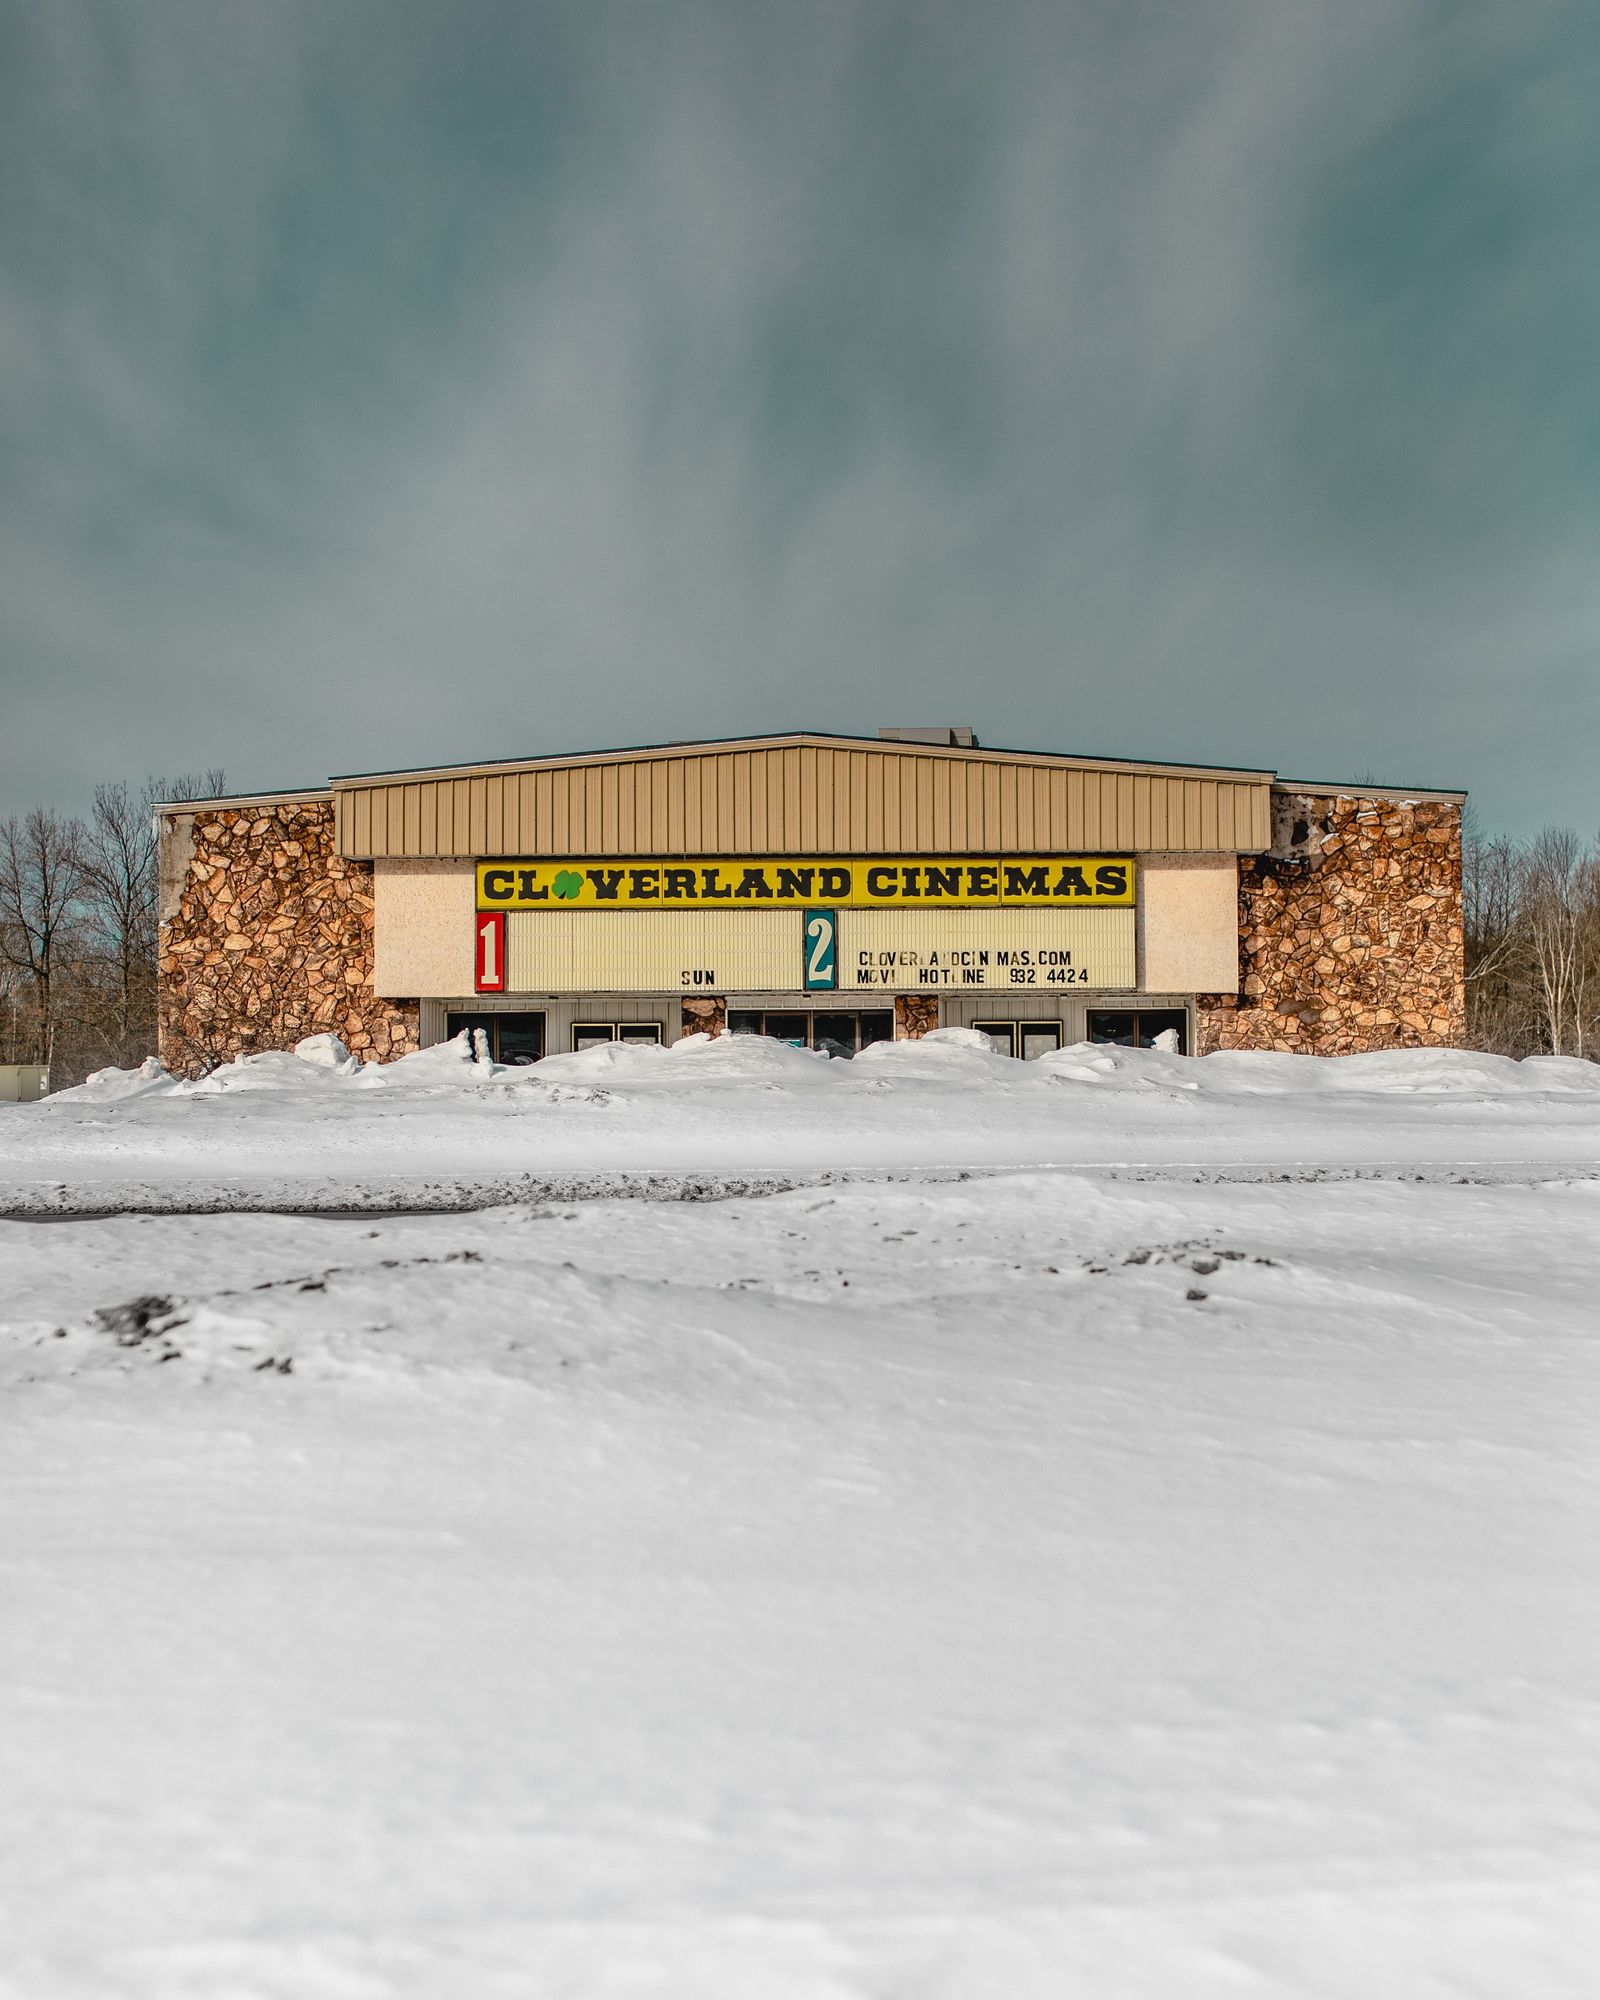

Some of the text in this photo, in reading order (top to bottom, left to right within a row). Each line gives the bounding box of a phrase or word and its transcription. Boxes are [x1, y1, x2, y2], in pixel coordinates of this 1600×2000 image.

[868, 866, 1127, 897] CINEMAS
[480, 921, 499, 984] 1
[807, 918, 833, 982] 2
[681, 970, 714, 985] SUN
[1010, 968, 1036, 983] 932
[1047, 968, 1089, 983] 4424
